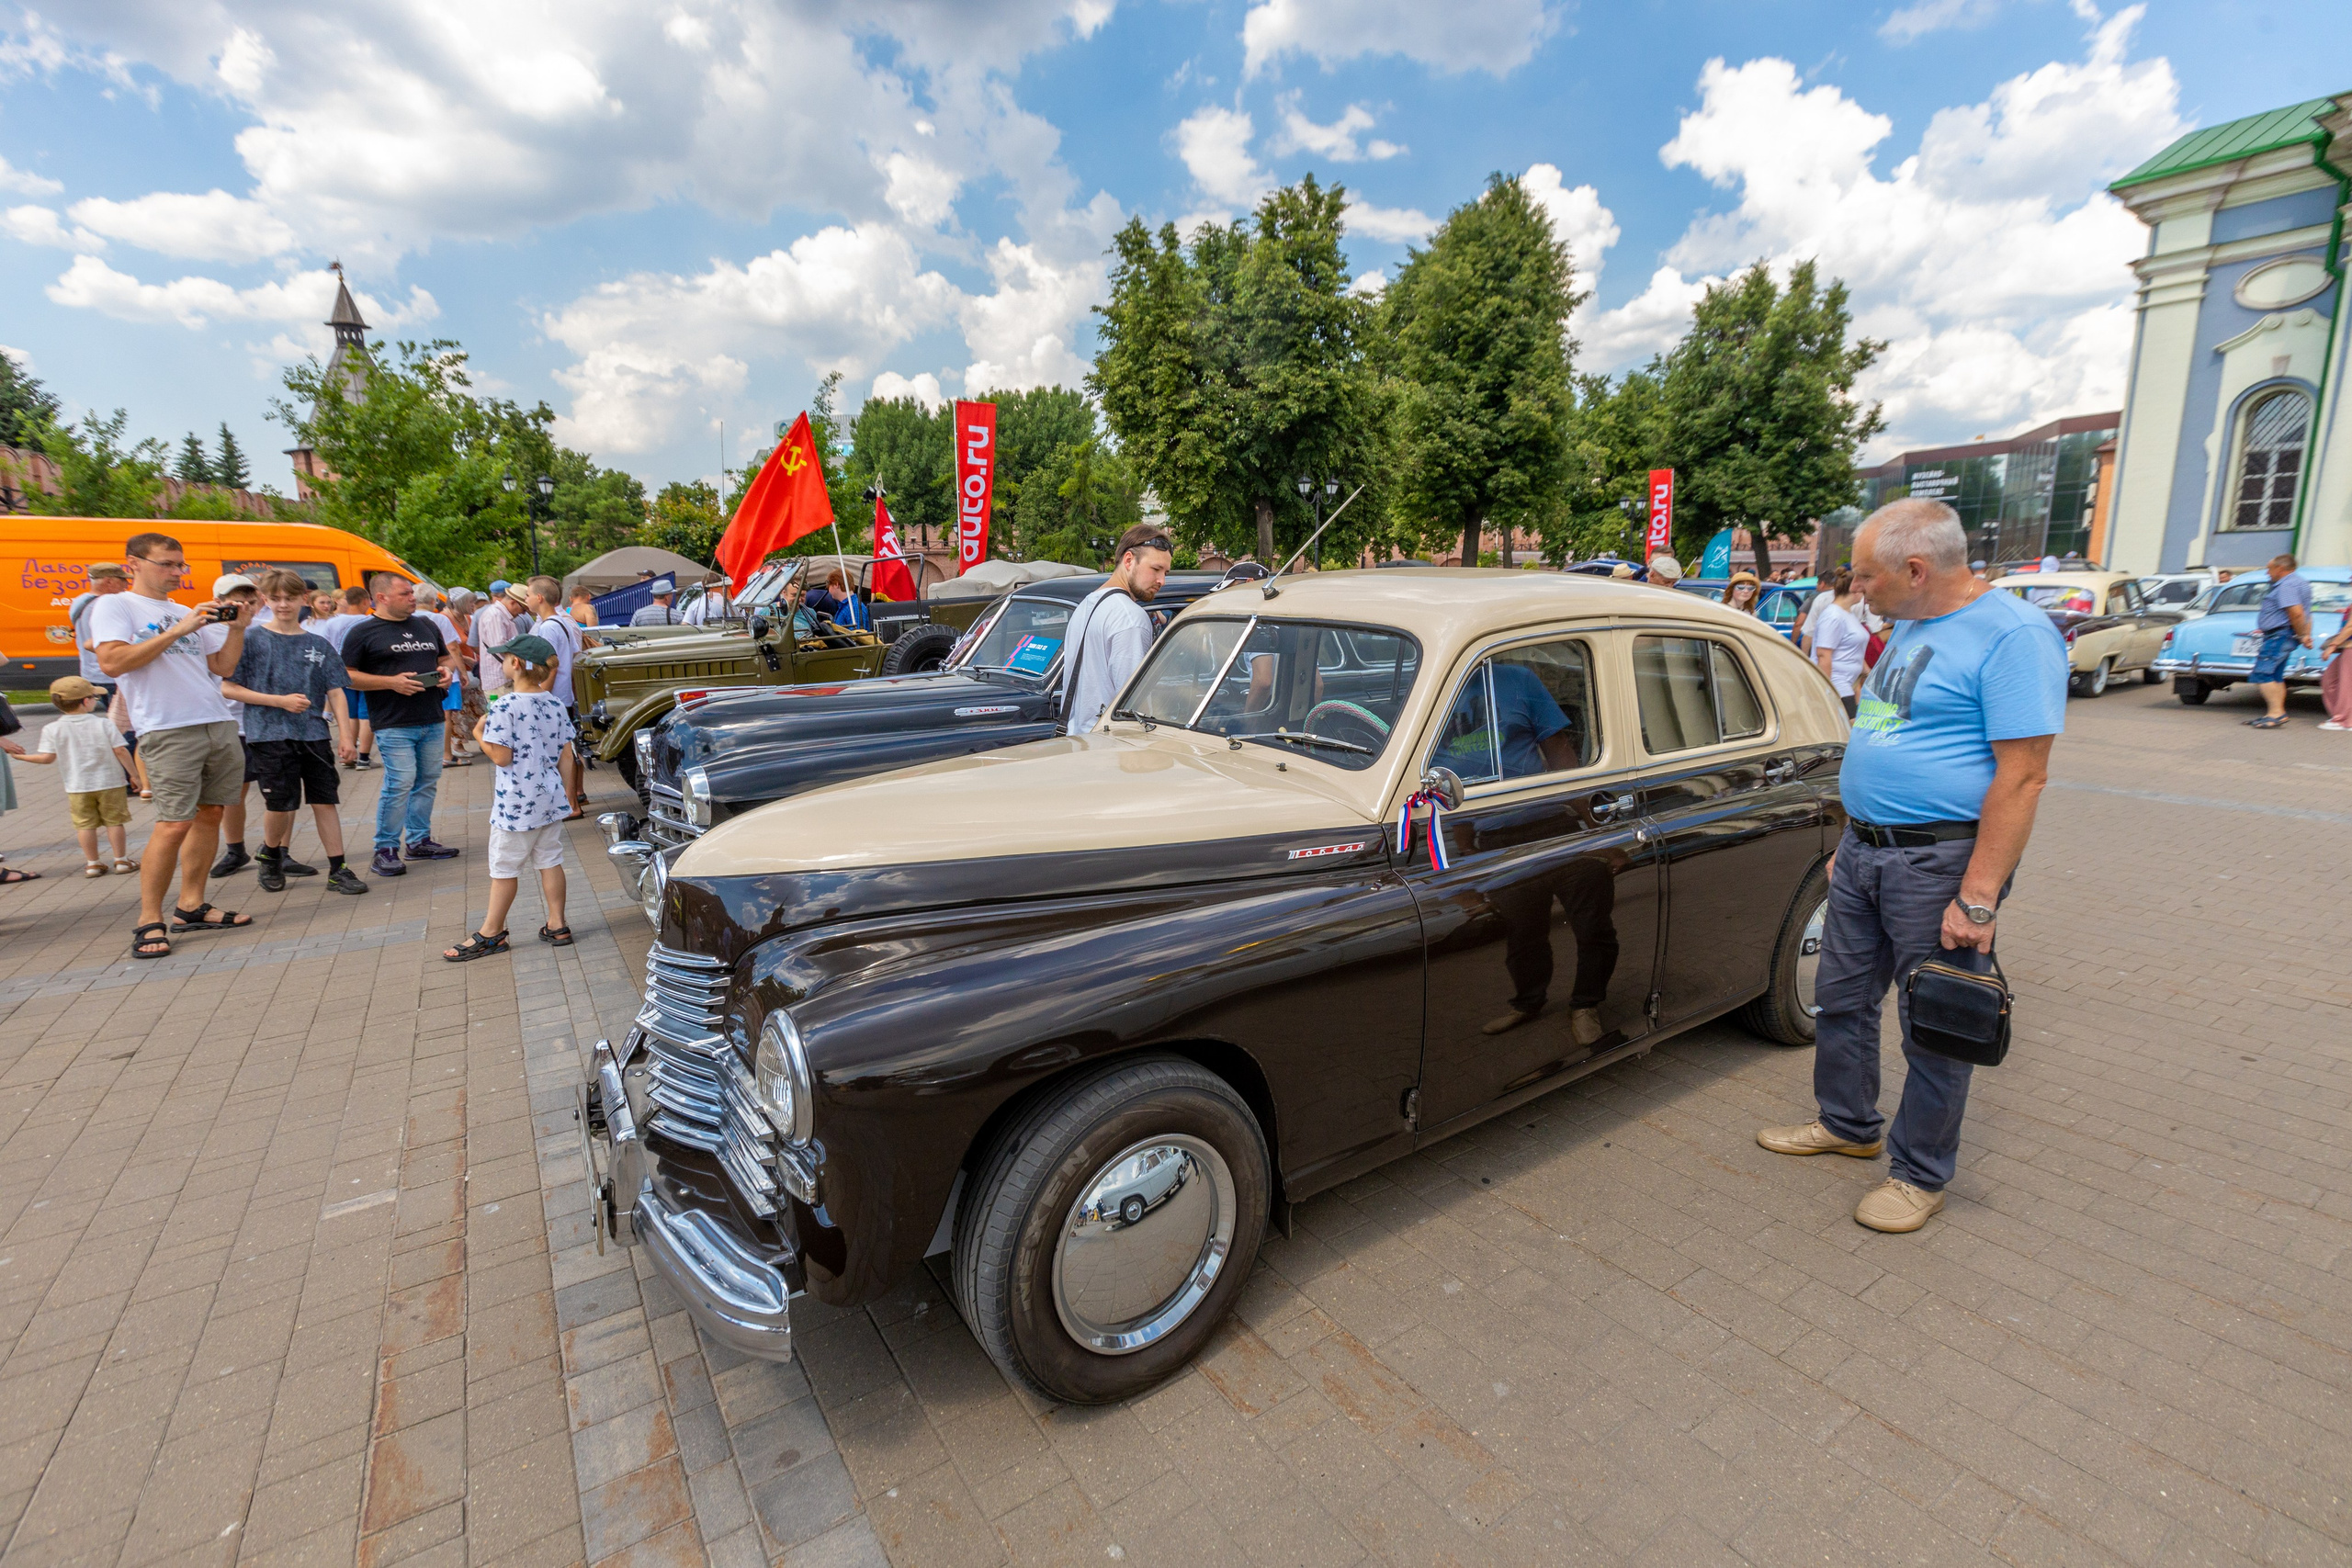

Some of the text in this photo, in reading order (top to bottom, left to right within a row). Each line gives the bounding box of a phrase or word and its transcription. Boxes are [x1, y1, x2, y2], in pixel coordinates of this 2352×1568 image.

[963, 425, 989, 562] auto.ru
[1649, 484, 1668, 546] to.ru
[390, 641, 436, 653] adidas
[1853, 714, 1905, 732] DISTRICT
[1859, 699, 1899, 716] RUNNING
[1019, 1145, 1090, 1312] NEXEN
